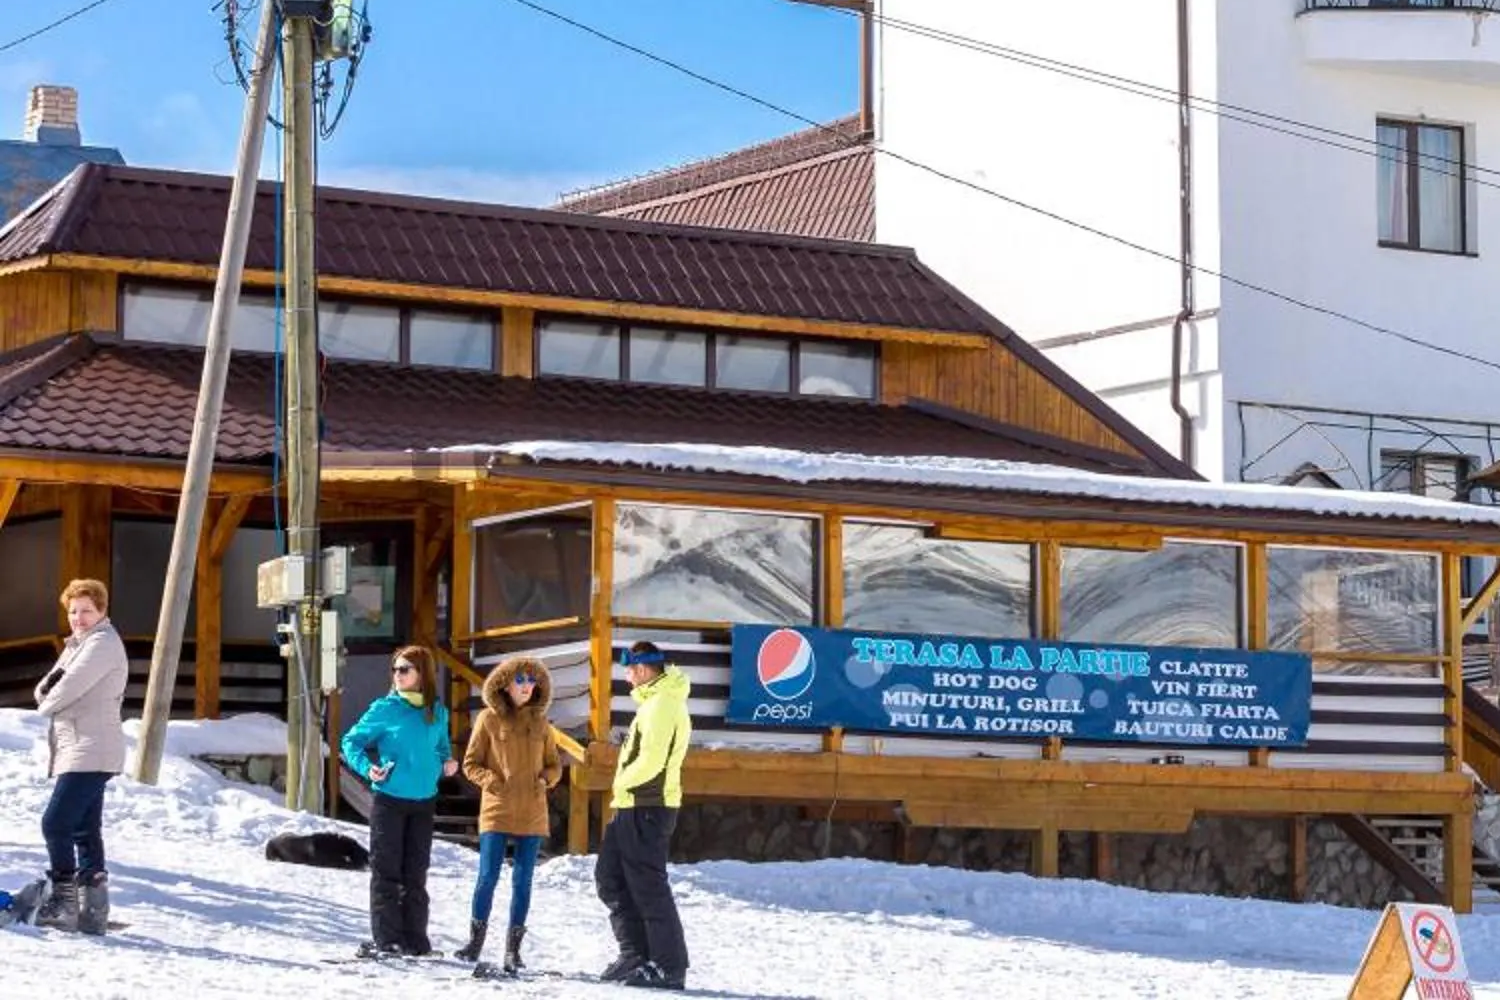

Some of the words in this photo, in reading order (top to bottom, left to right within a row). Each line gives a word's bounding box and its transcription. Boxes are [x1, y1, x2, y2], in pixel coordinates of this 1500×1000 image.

[852, 637, 984, 669] TERASA
[989, 645, 1034, 671] LA
[1039, 646, 1151, 677] PARTIE
[1159, 660, 1249, 679] CLATITE
[932, 672, 982, 689] HOT
[988, 675, 1038, 691] DOG
[1151, 680, 1190, 696] VIN
[1196, 683, 1257, 699] FIERT
[752, 701, 813, 722] pepsi
[882, 690, 1011, 714] MINUTURI,
[1017, 697, 1085, 713] GRILL
[1127, 699, 1195, 718] TUICA
[1200, 703, 1280, 721] FIARTA
[889, 713, 930, 728] PUI
[936, 714, 967, 730] LA
[974, 716, 1075, 734] ROTISOR
[1114, 720, 1214, 738] BAUTURI
[1219, 725, 1289, 741] CALDE
